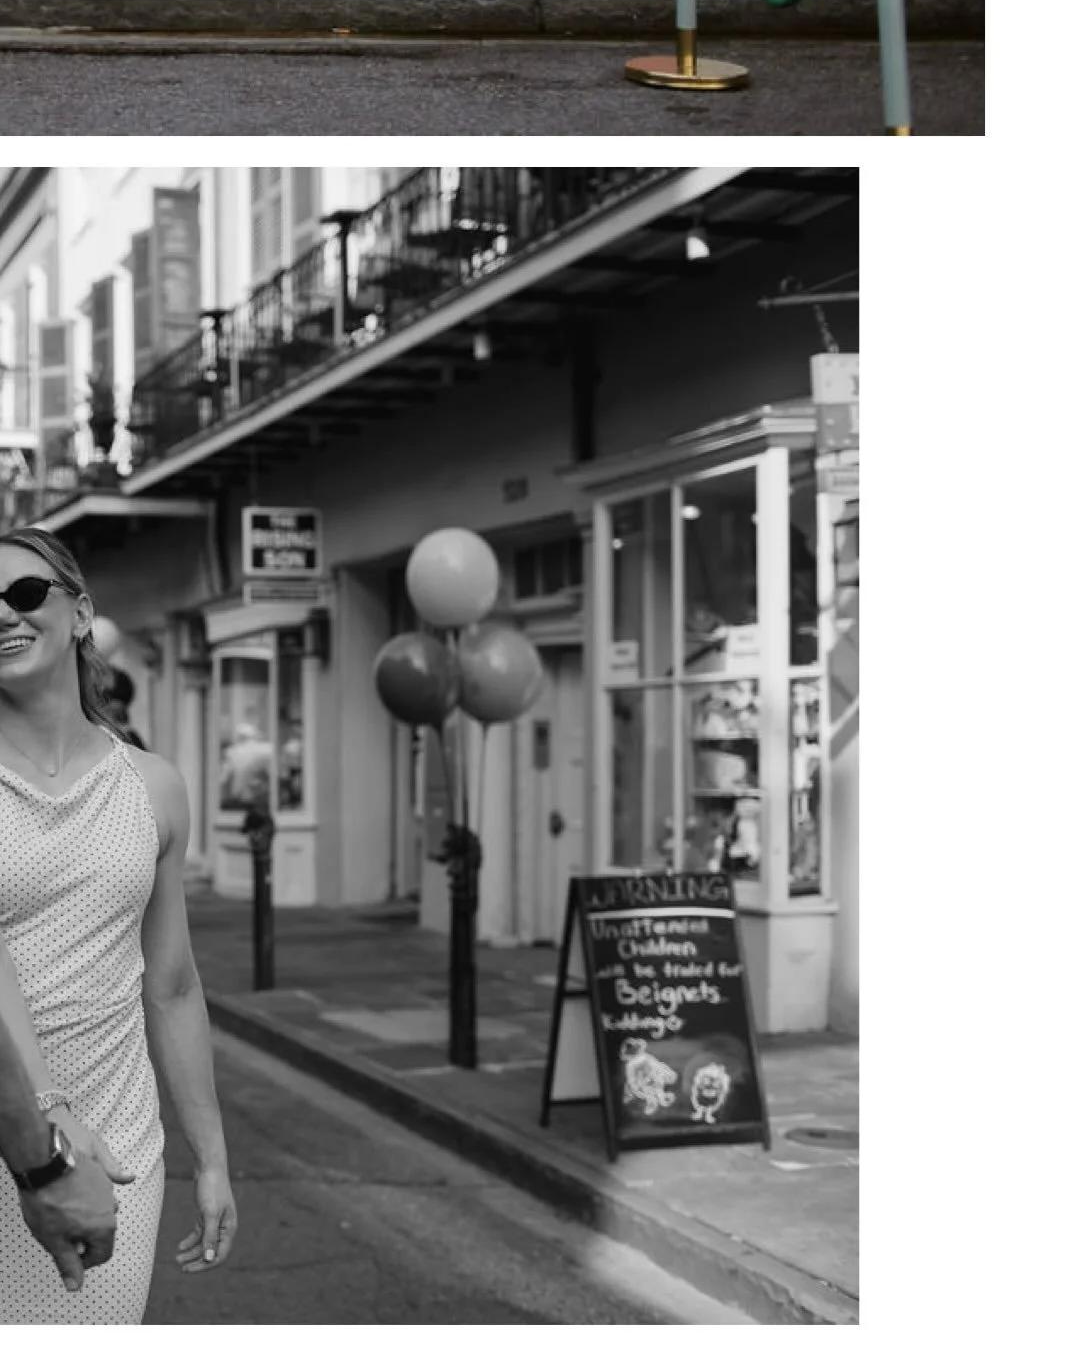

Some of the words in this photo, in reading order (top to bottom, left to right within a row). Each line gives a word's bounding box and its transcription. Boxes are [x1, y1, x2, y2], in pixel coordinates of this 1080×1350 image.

[251, 530, 313, 548] RISING
[617, 936, 698, 960] Children
[632, 961, 657, 979] be
[614, 978, 722, 1017] Beignets
